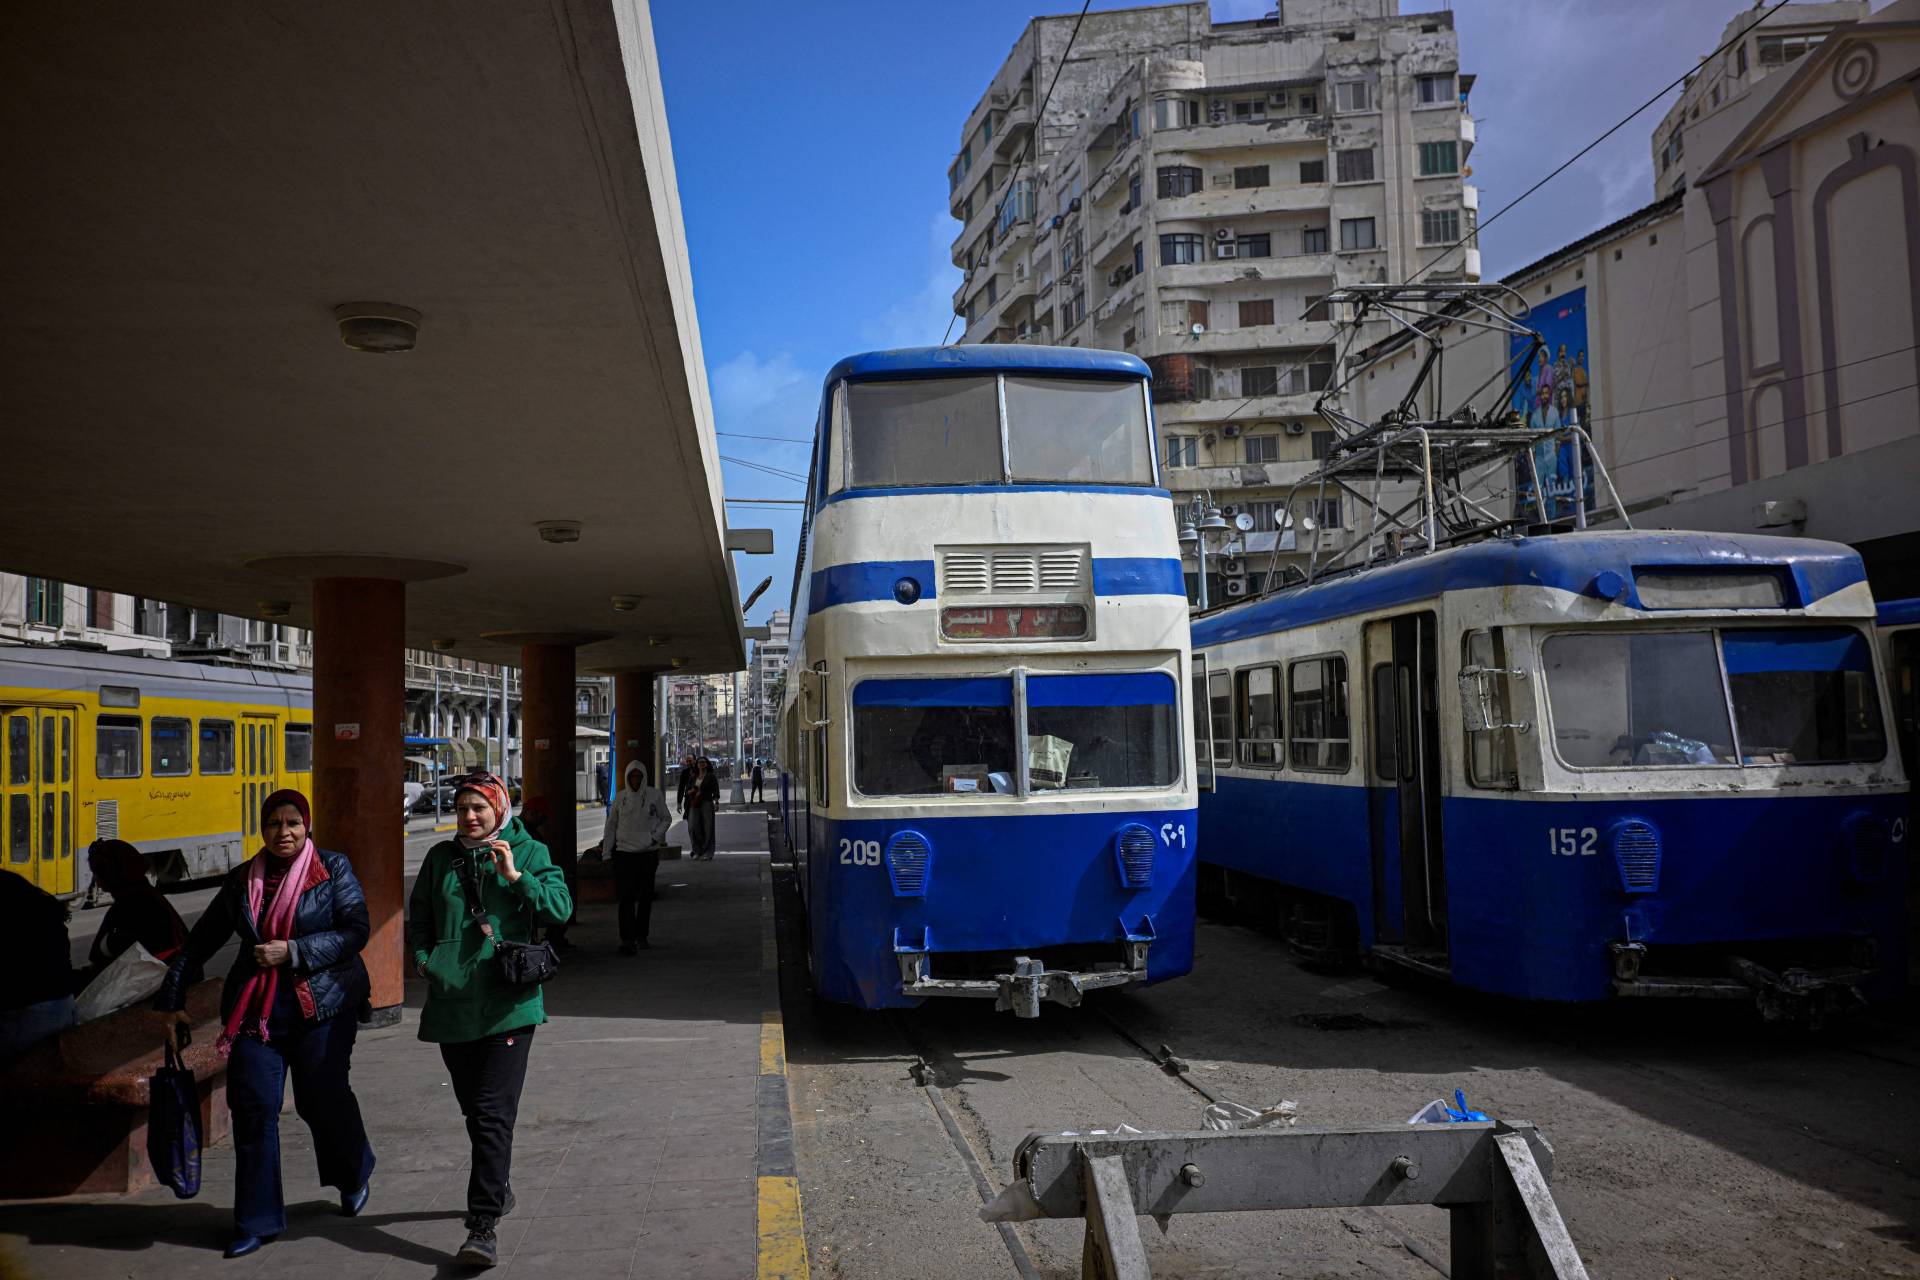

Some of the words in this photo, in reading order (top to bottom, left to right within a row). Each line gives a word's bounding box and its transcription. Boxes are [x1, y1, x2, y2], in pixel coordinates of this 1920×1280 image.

[1160, 823, 1186, 849] ٢٠٩
[1549, 827, 1599, 856] 152
[839, 838, 881, 866] 209
